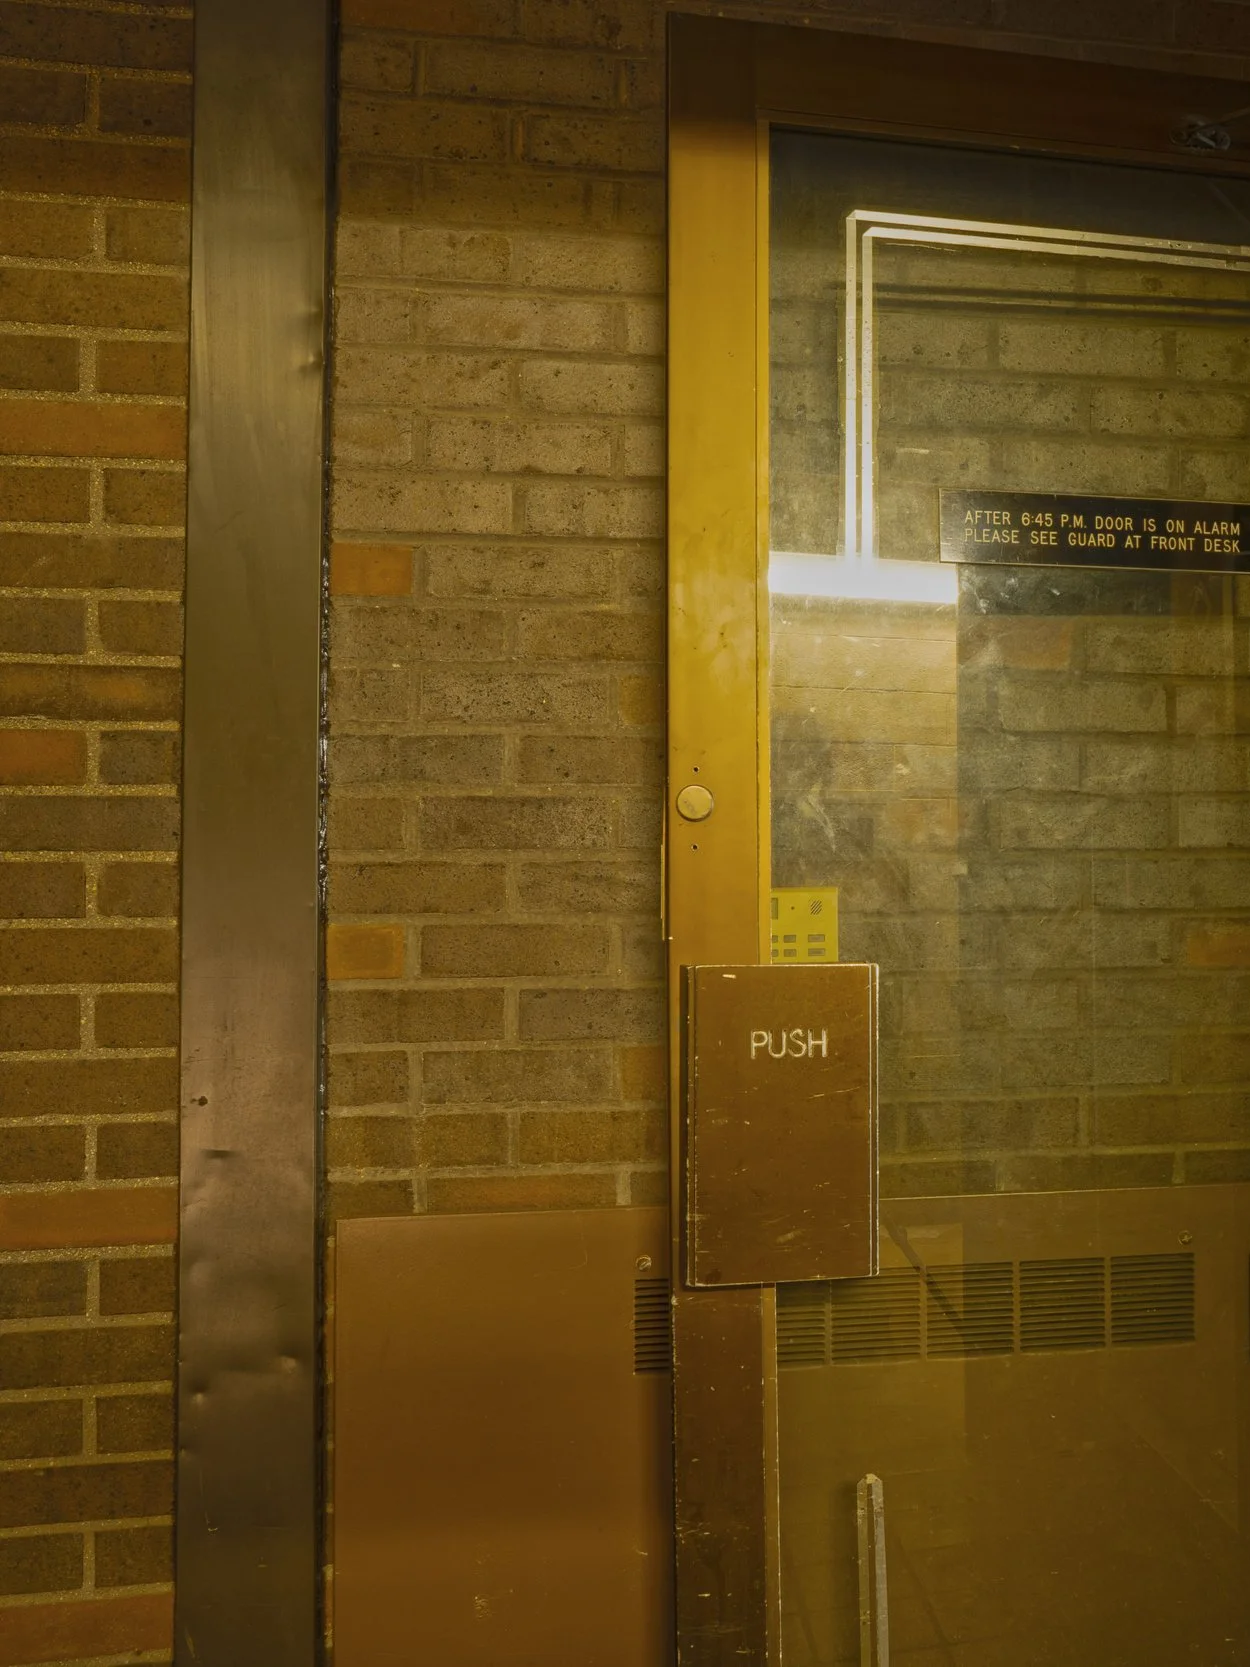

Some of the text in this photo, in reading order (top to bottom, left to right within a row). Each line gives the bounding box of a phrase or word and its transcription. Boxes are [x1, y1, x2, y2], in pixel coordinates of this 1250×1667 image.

[964, 510, 1240, 536] AFTER 6:45 P.M. DOOR IS ON ALARM
[964, 528, 1240, 553] PLEASE SEE GUARD AT FRONT DESK
[750, 1028, 828, 1060] PUSH
